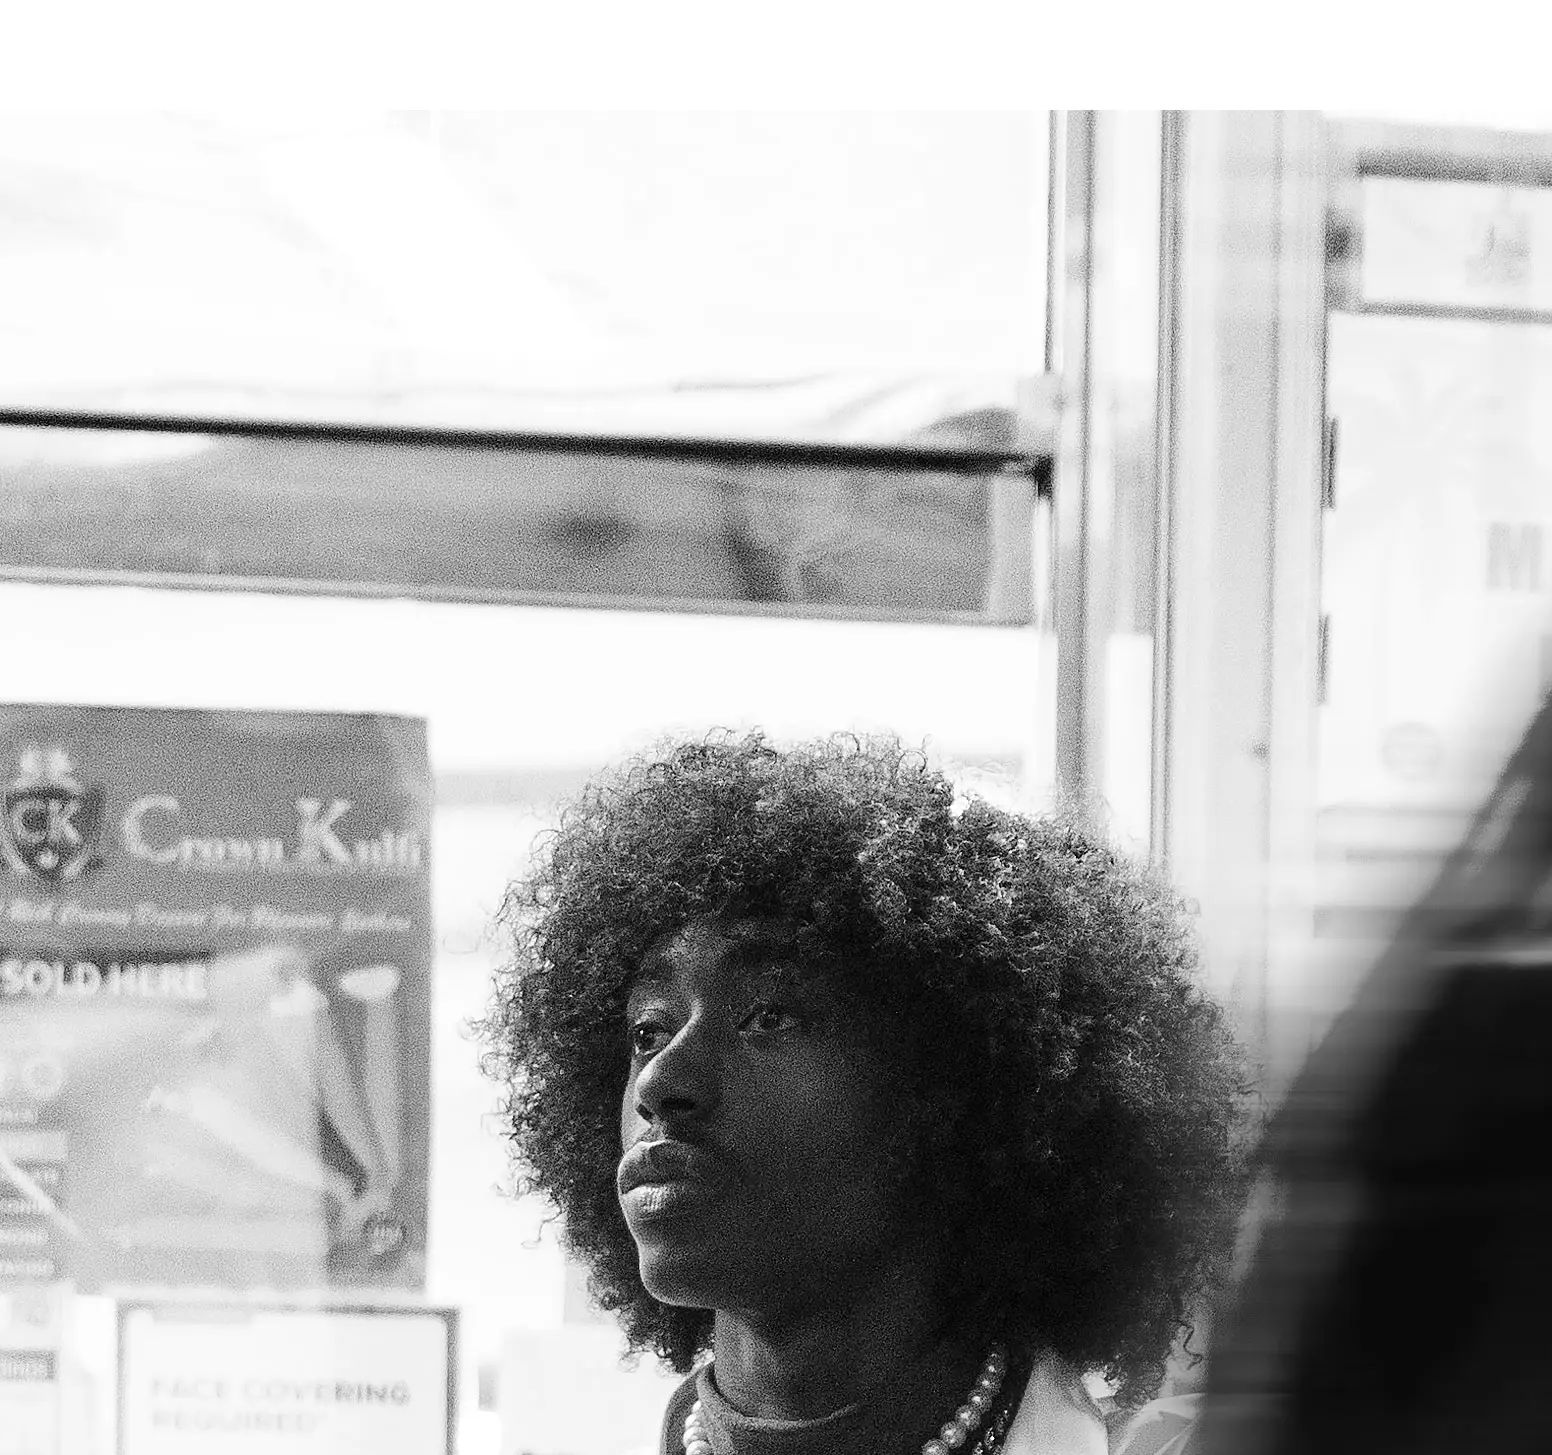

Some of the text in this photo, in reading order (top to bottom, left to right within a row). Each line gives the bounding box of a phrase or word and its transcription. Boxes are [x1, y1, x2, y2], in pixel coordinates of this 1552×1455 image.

[13, 799, 81, 844] CK
[122, 795, 283, 866] Crown
[105, 961, 207, 1001] HERE
[151, 1378, 411, 1406] FACE COVERING
